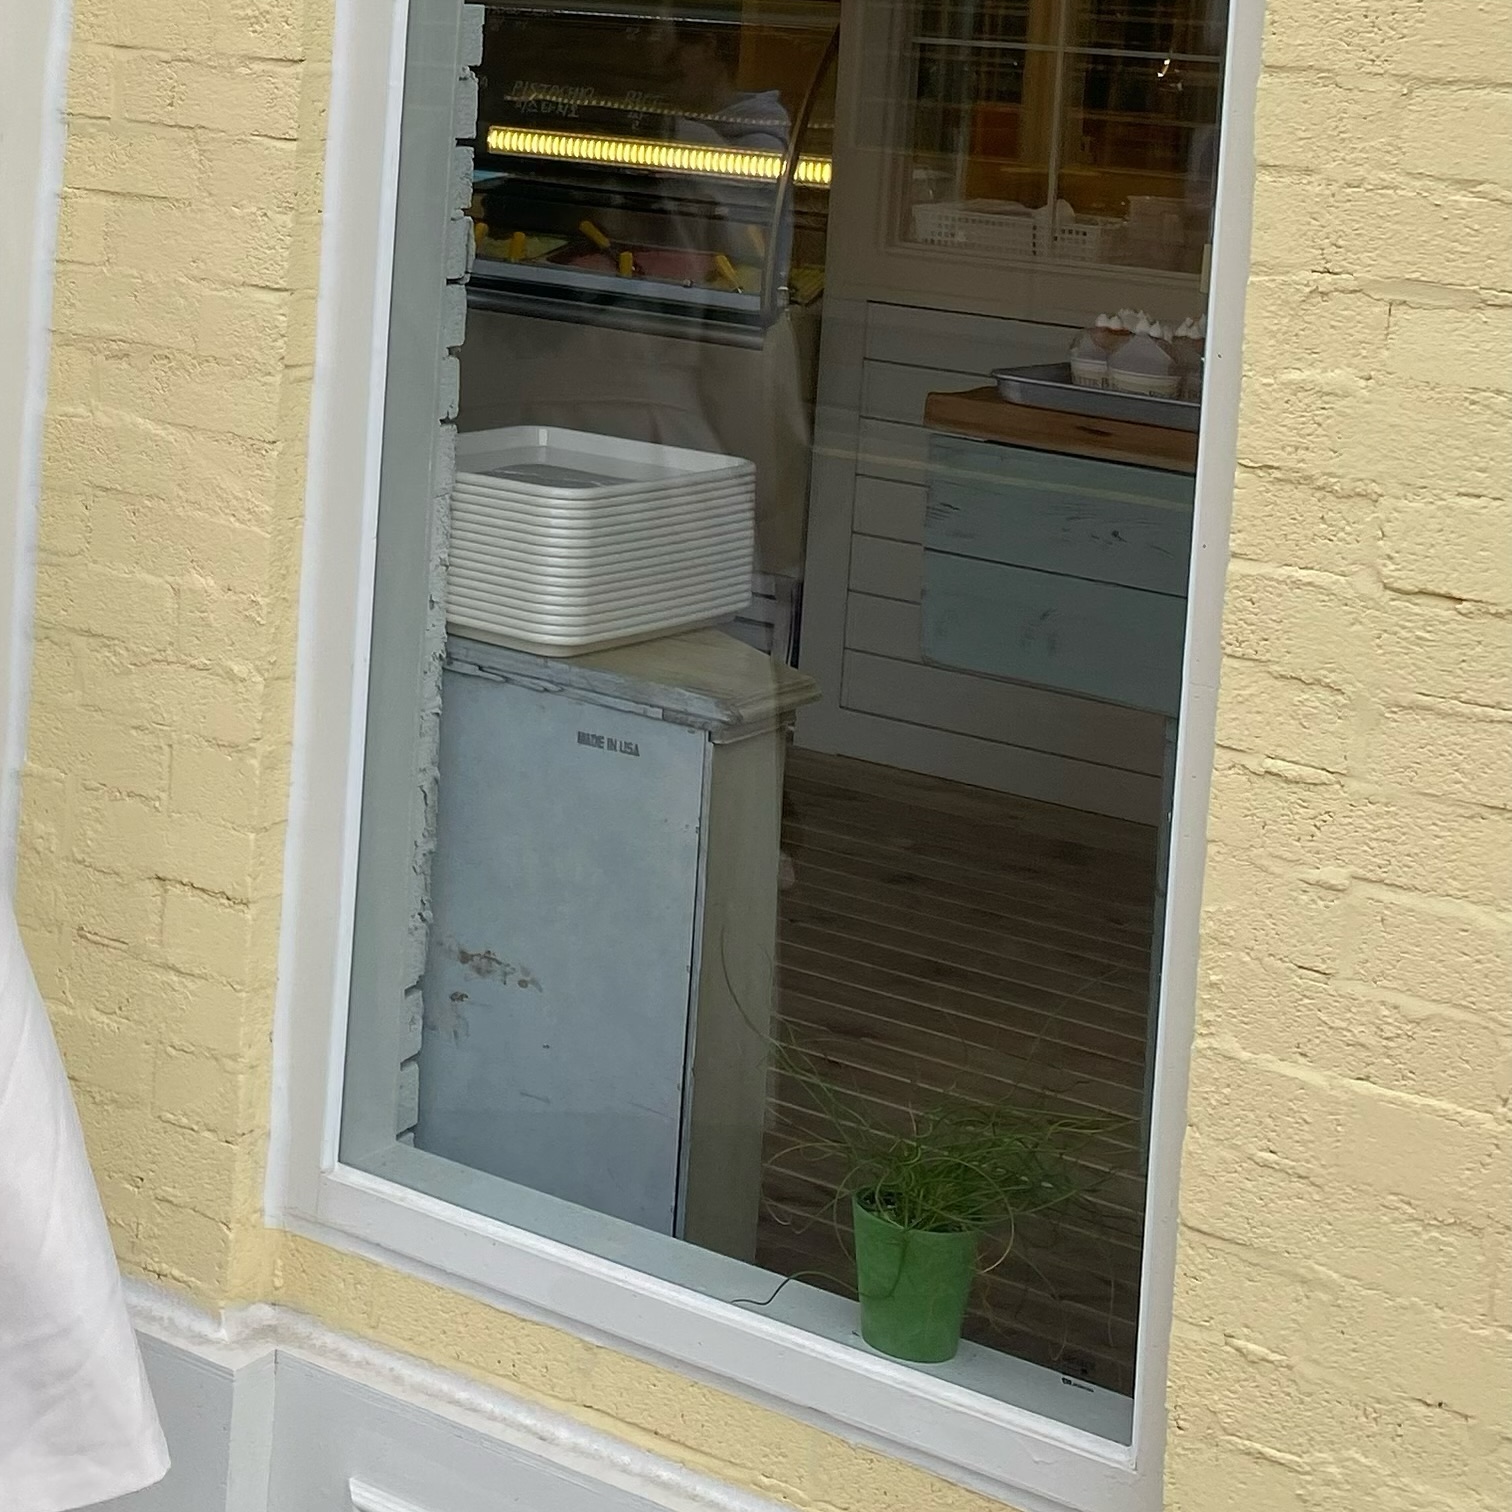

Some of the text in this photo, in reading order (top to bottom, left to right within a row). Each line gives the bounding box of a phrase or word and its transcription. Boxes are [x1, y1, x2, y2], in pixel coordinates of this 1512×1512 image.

[577, 731, 640, 756] MADE IN USA
